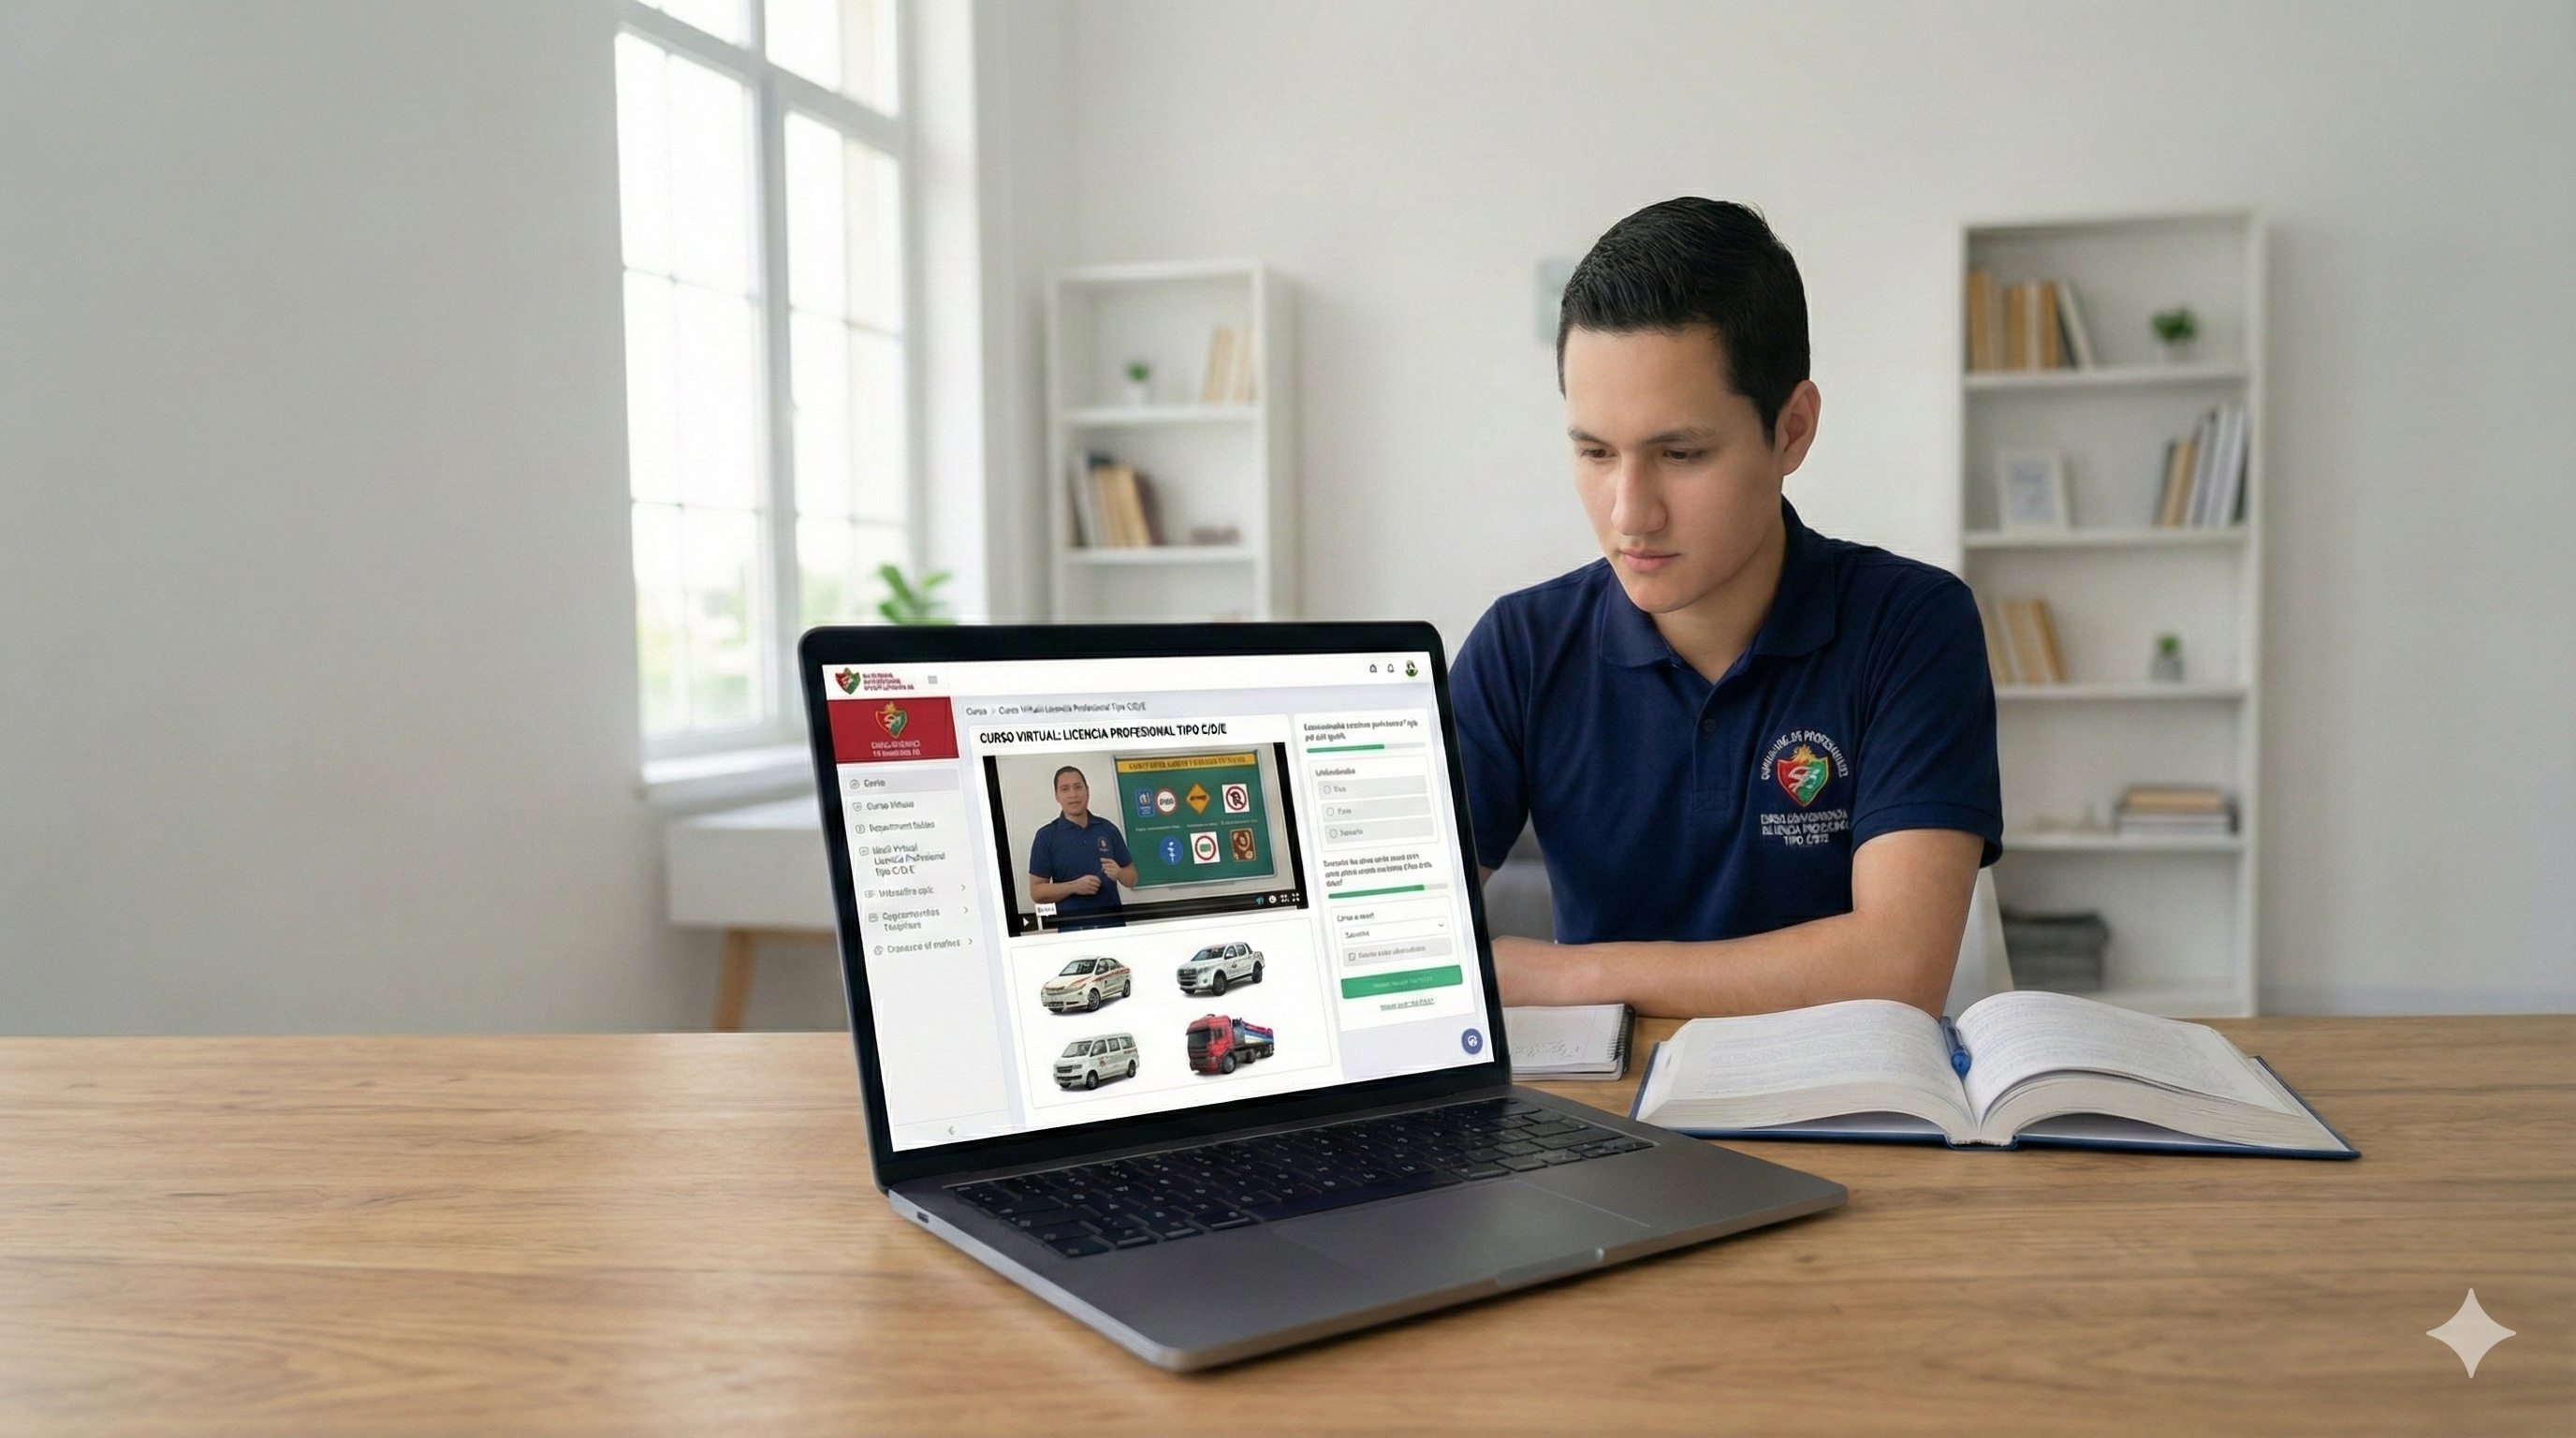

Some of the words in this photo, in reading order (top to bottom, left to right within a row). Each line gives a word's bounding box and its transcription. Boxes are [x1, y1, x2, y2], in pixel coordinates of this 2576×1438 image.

[980, 732, 1015, 744] CURSO
[1063, 728, 1108, 741] LICENCIA
[1110, 726, 1176, 739] PROFESIONAL
[1177, 724, 1199, 736] TIPO
[1202, 723, 1227, 735] C/D/E
